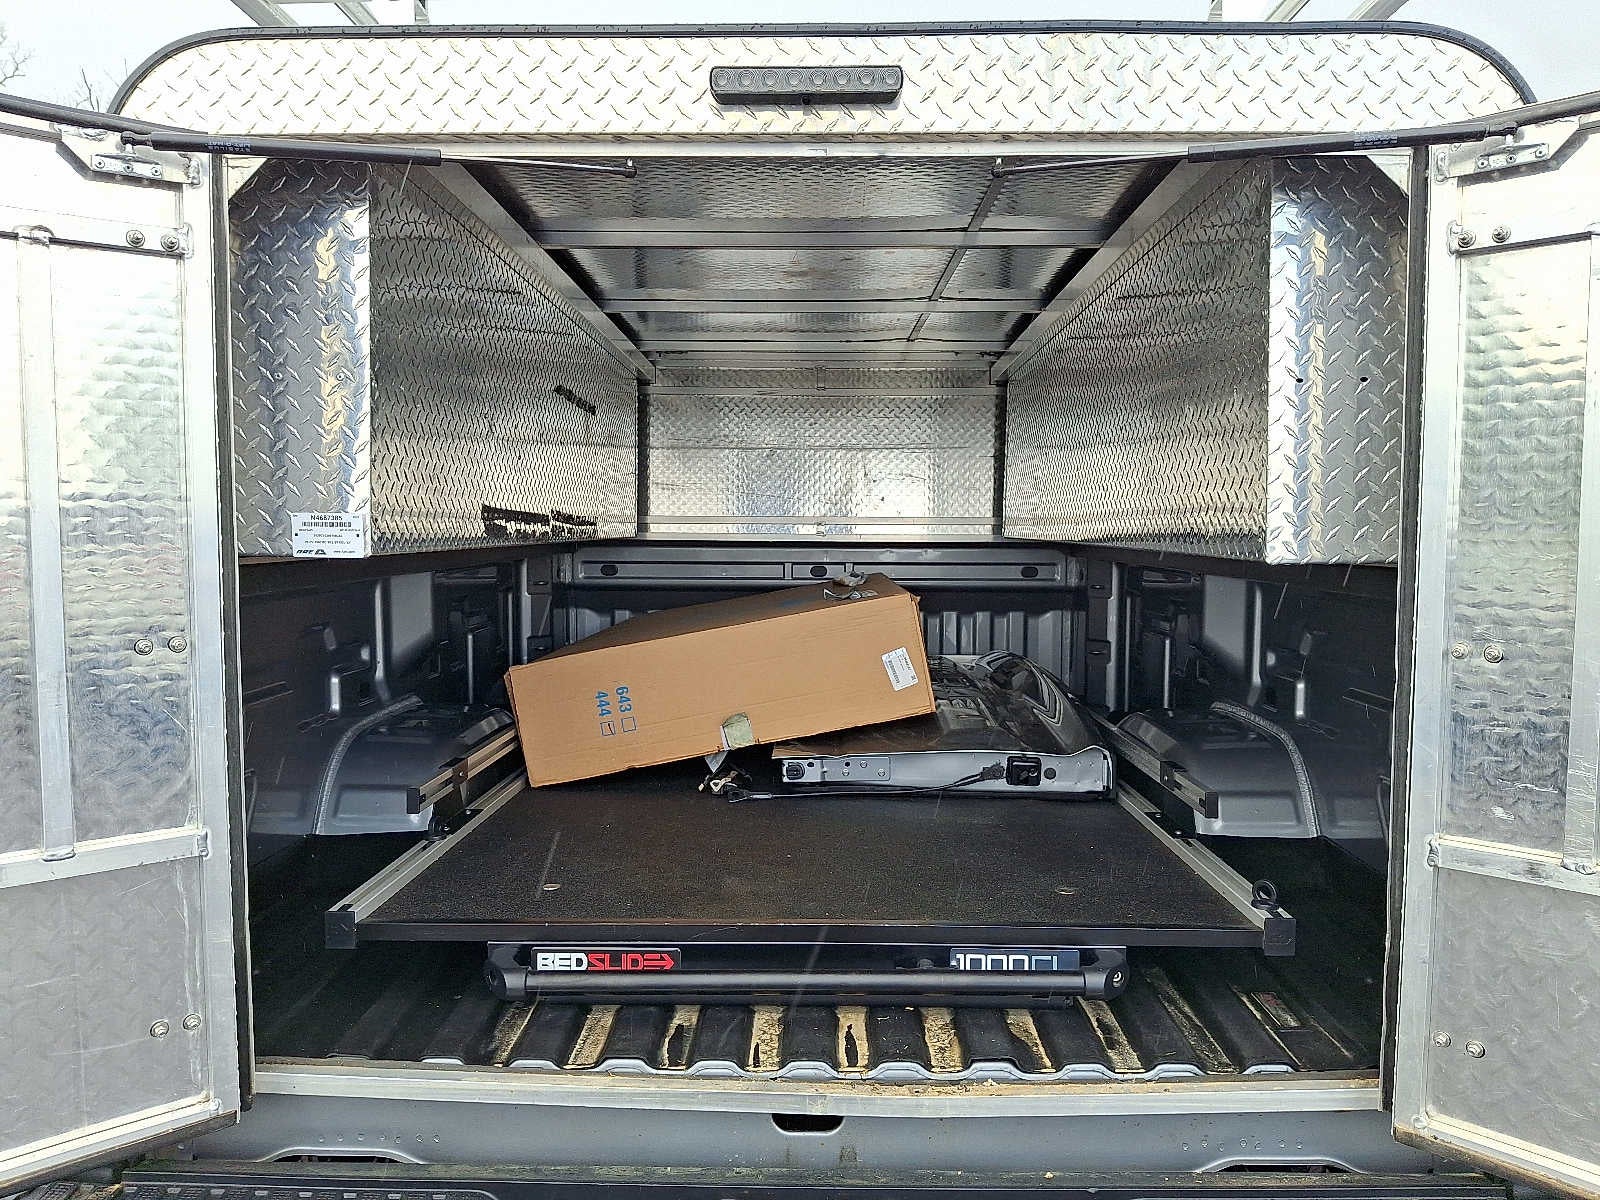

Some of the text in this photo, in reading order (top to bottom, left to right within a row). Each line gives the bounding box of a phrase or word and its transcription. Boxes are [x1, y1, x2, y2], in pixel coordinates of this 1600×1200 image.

[595, 691, 612, 717] 444
[616, 686, 632, 712] 643
[537, 953, 675, 970] BEDSLIDE
